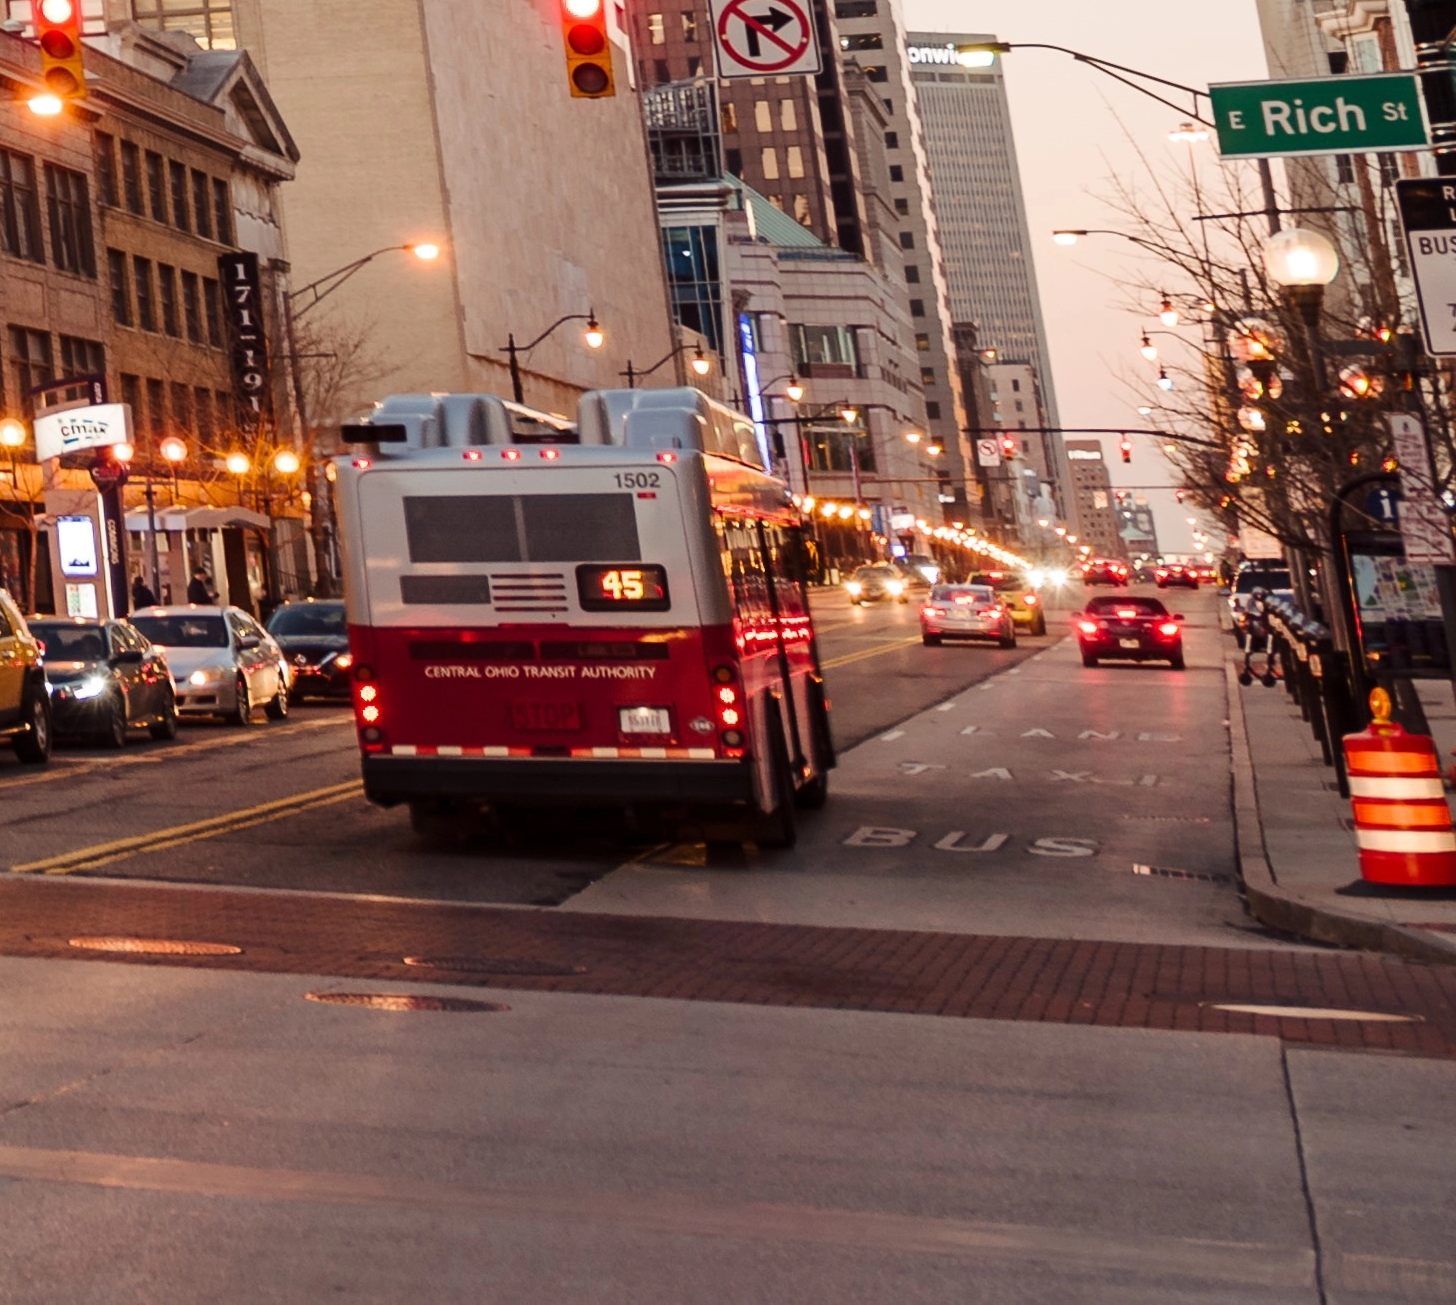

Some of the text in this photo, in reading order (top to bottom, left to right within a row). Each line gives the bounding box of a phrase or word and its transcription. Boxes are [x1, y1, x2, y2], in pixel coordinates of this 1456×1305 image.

[1228, 97, 1409, 136] E Rich St
[614, 472, 661, 488] 1502
[602, 571, 644, 600] 45
[425, 666, 655, 679] CENTRAL OHIO TRANSIT AUTHORITY
[515, 703, 575, 727] STOP
[900, 762, 1161, 788] TAXI
[842, 826, 1101, 857] BUS
